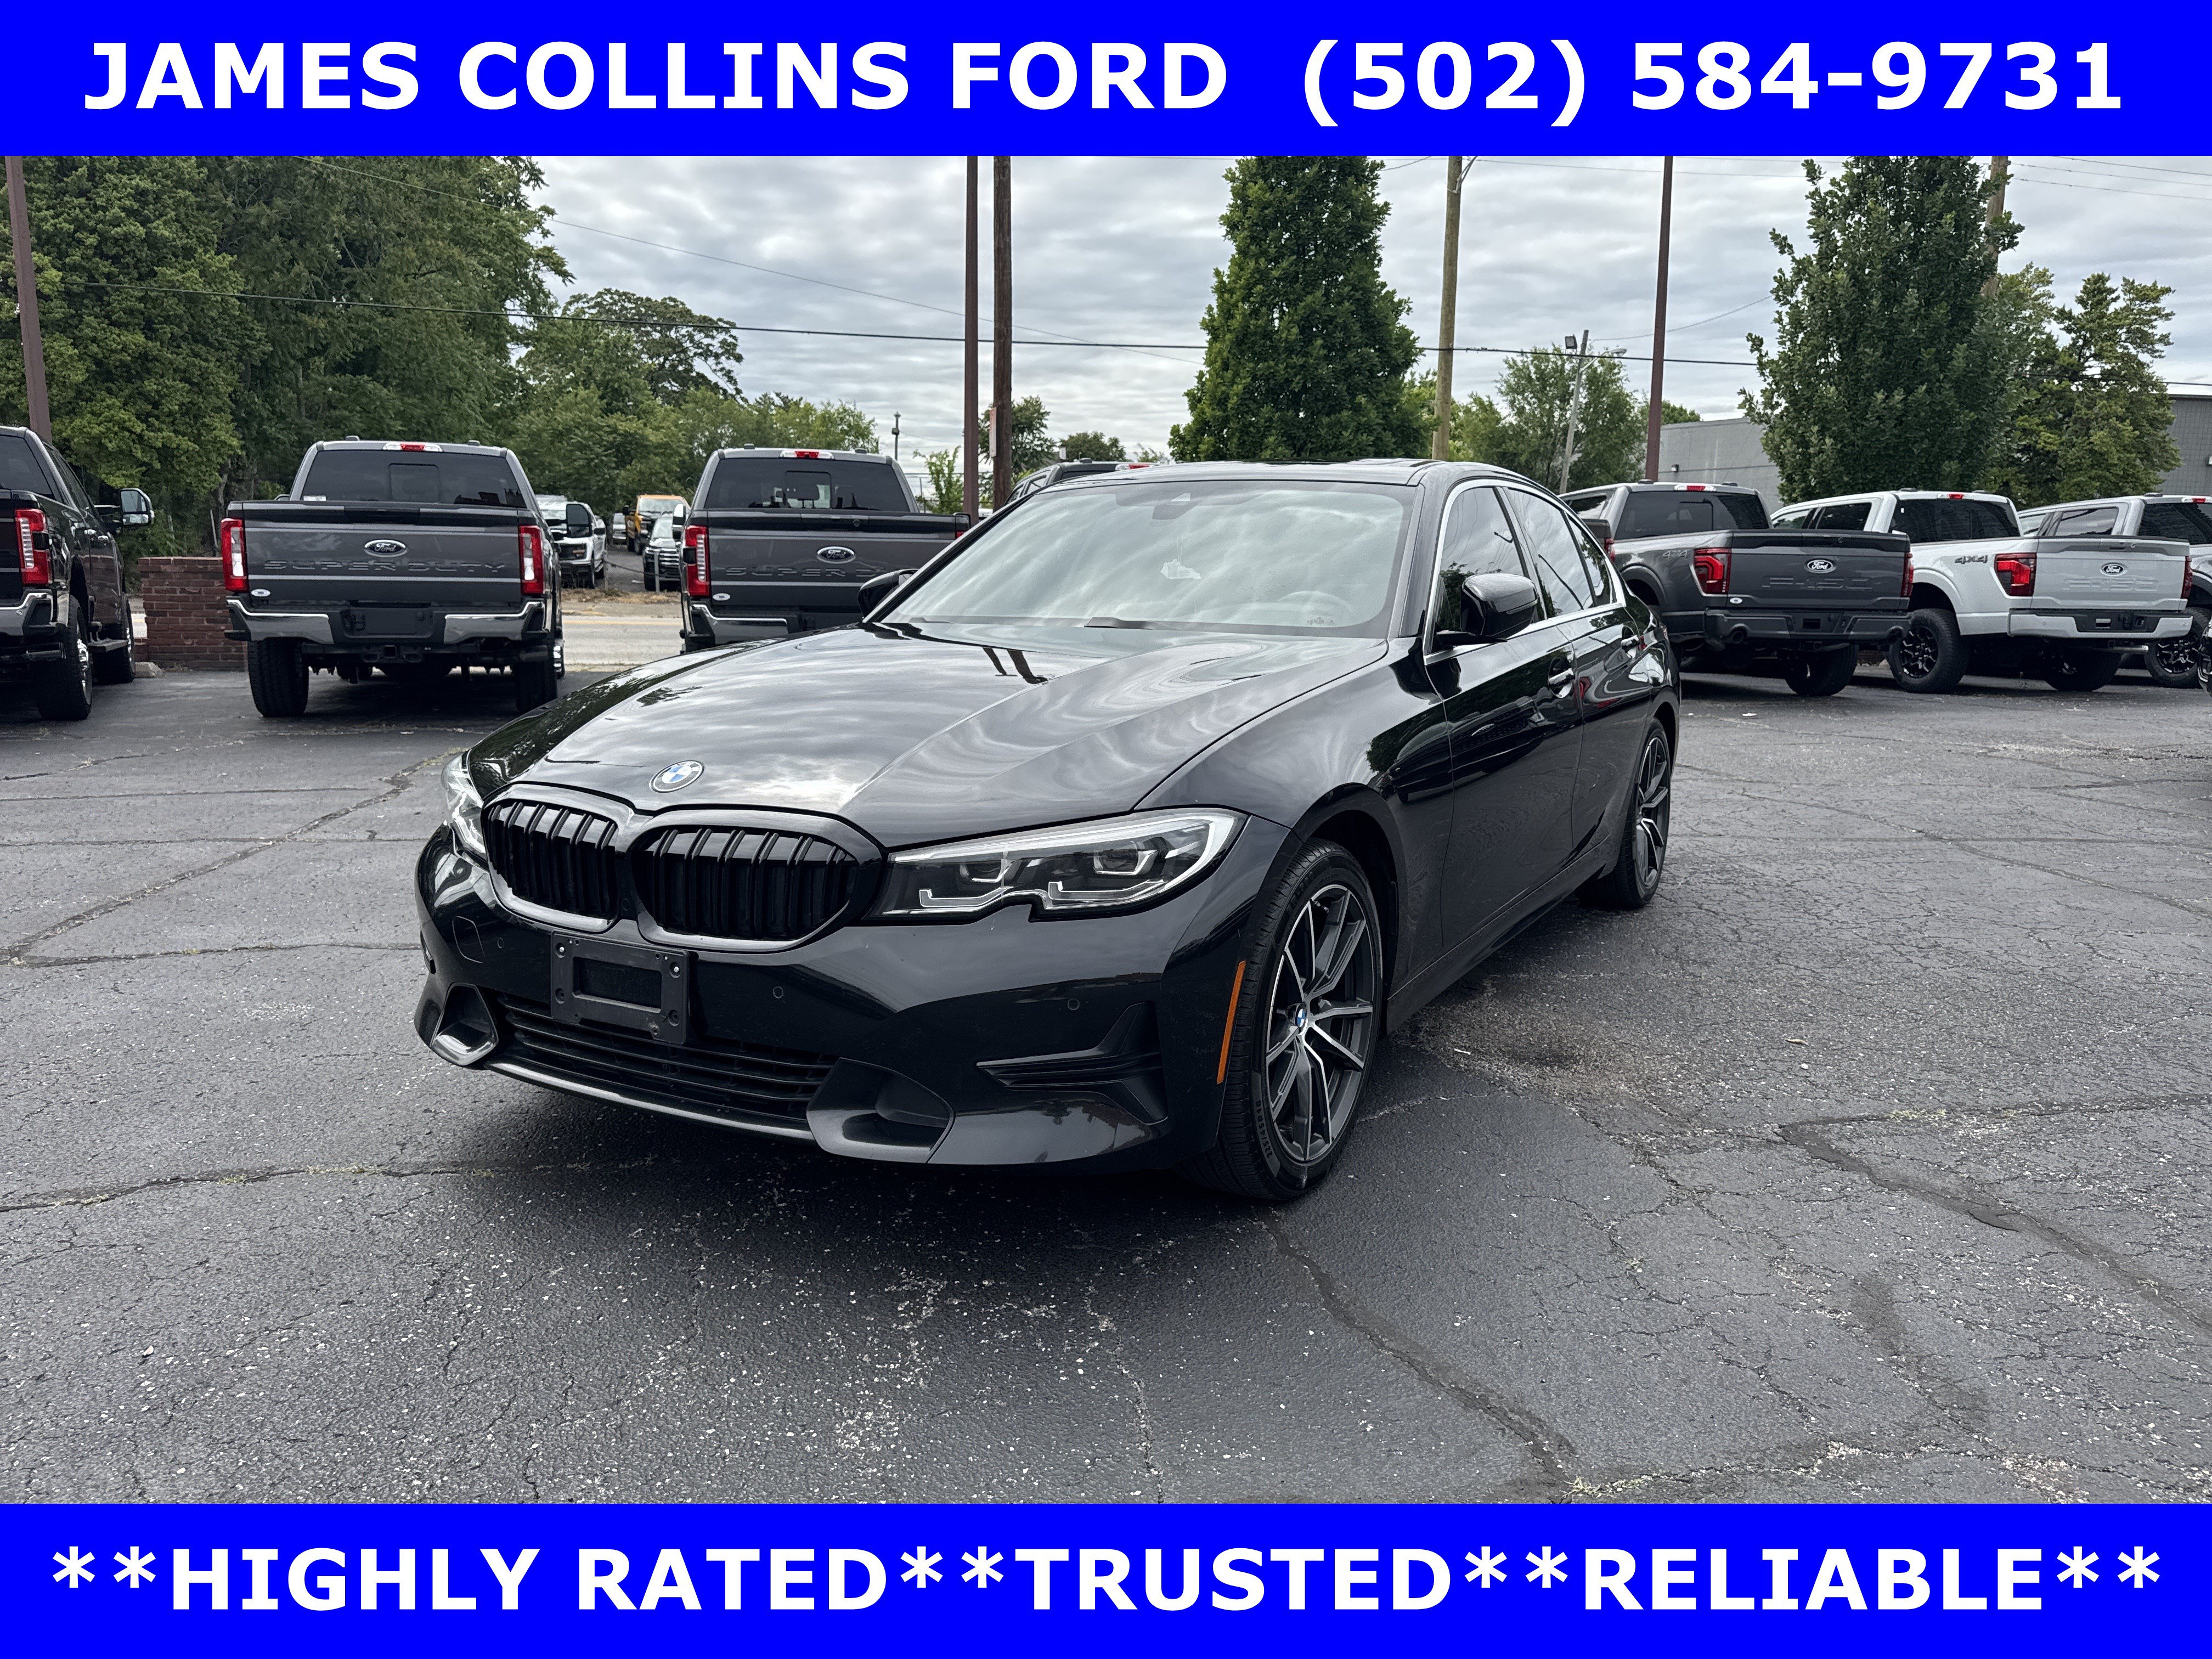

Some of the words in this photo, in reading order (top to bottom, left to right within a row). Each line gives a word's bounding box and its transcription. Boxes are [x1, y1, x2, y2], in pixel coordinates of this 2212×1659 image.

[264, 561, 396, 571] SUPER
[408, 562, 505, 572] DUTY
[726, 567, 845, 576] SUPER
[1256, 1100, 1273, 1158] 225/45R18
